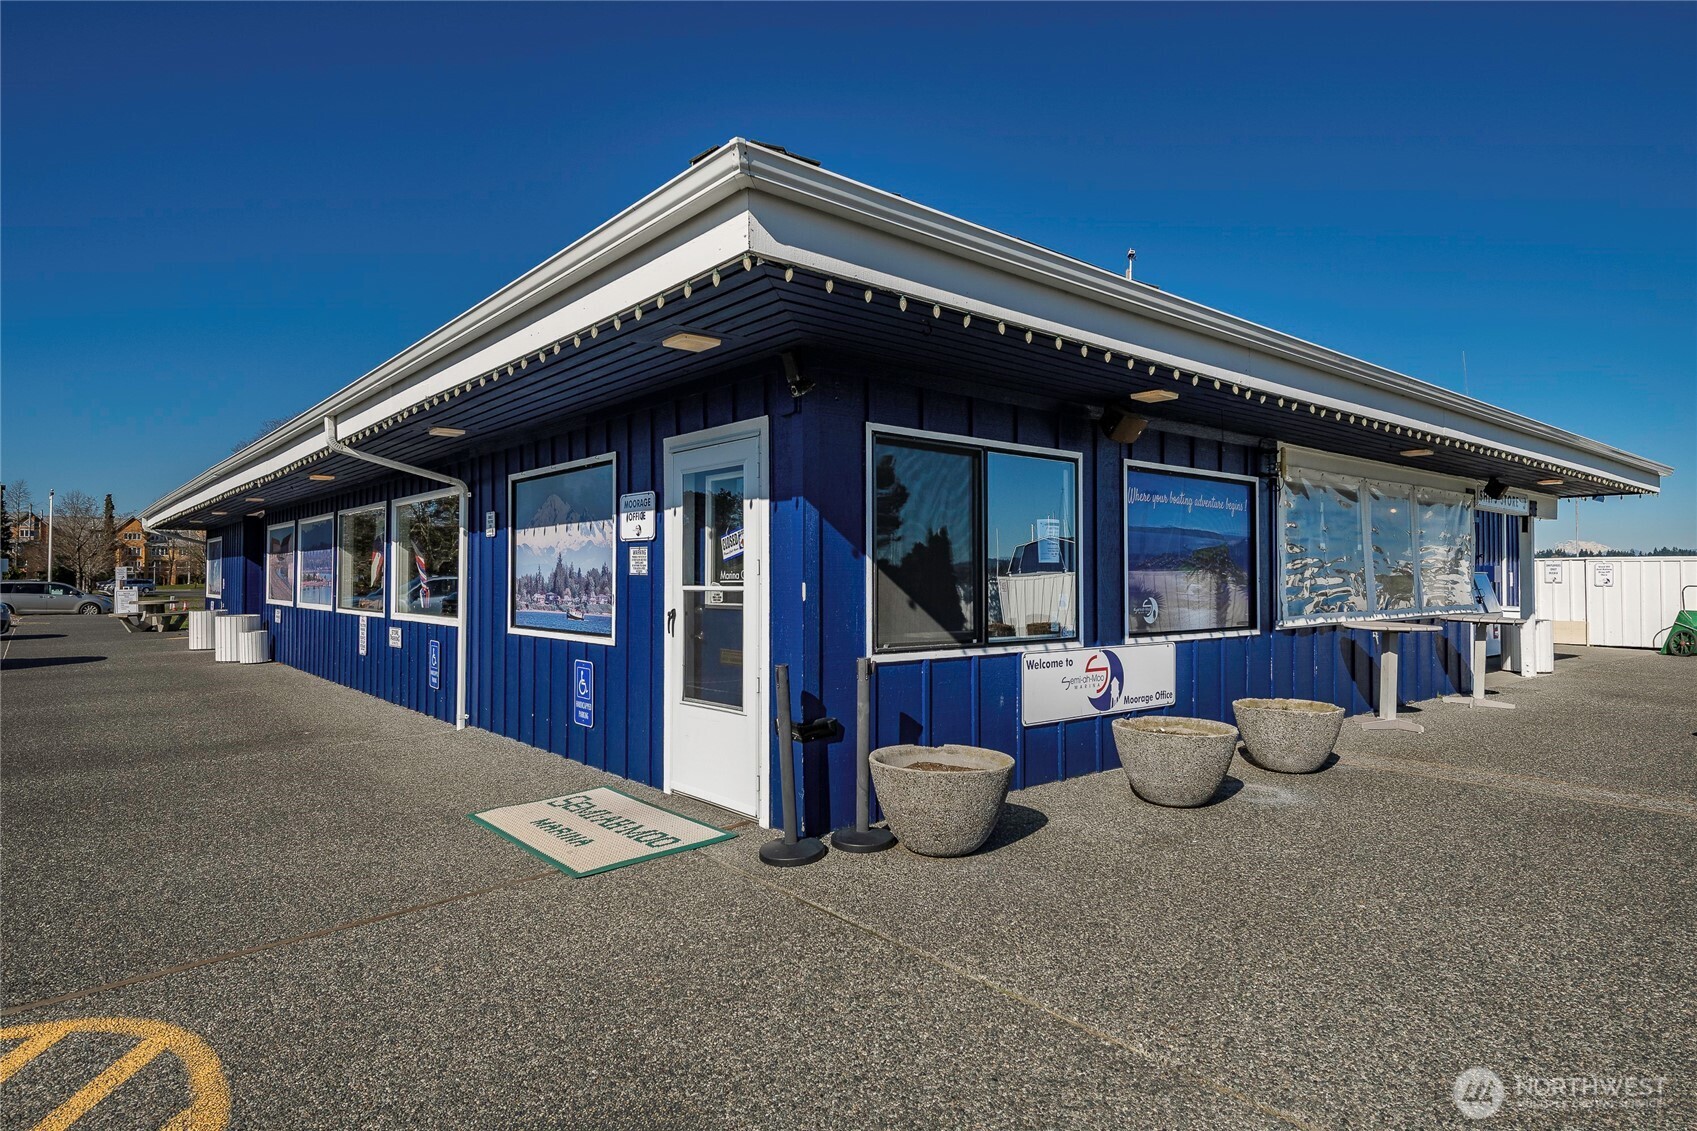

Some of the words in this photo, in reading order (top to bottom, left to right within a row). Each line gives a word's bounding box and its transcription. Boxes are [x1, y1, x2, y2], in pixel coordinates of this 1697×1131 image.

[624, 497, 652, 509] MOORAGE
[1128, 486, 1152, 504] Where
[1152, 493, 1168, 509] your
[1170, 491, 1193, 513] boating
[1194, 495, 1224, 510] adventure
[628, 511, 646, 522] OFFICE
[720, 570, 740, 580] Marina
[1026, 659, 1064, 670] Welcome
[1066, 658, 1074, 666] to
[1062, 674, 1104, 690] Semi-ah-Moo
[1124, 694, 1154, 705] Moorage
[1154, 690, 1173, 700] Office
[530, 818, 595, 847] MARINA
